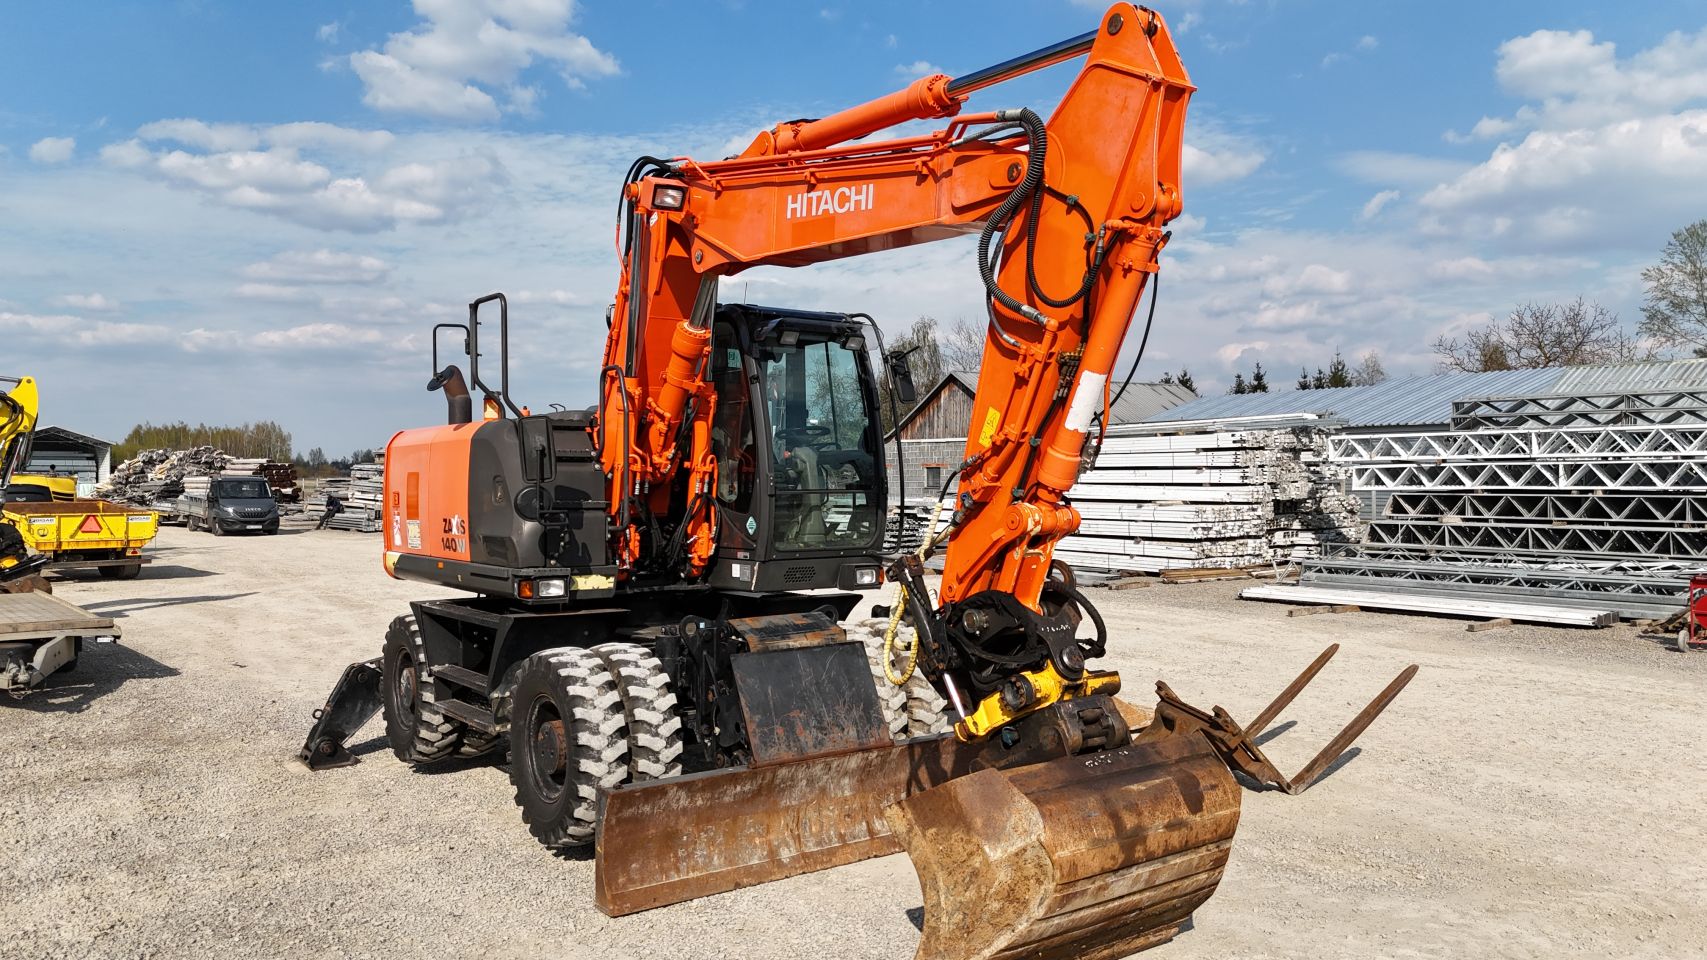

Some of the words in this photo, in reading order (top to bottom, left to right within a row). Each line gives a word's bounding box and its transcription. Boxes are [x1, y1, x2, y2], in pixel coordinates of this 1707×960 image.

[787, 184, 873, 219] HITACHI
[443, 514, 466, 535] ZAXIS
[441, 537, 466, 553] 140W
